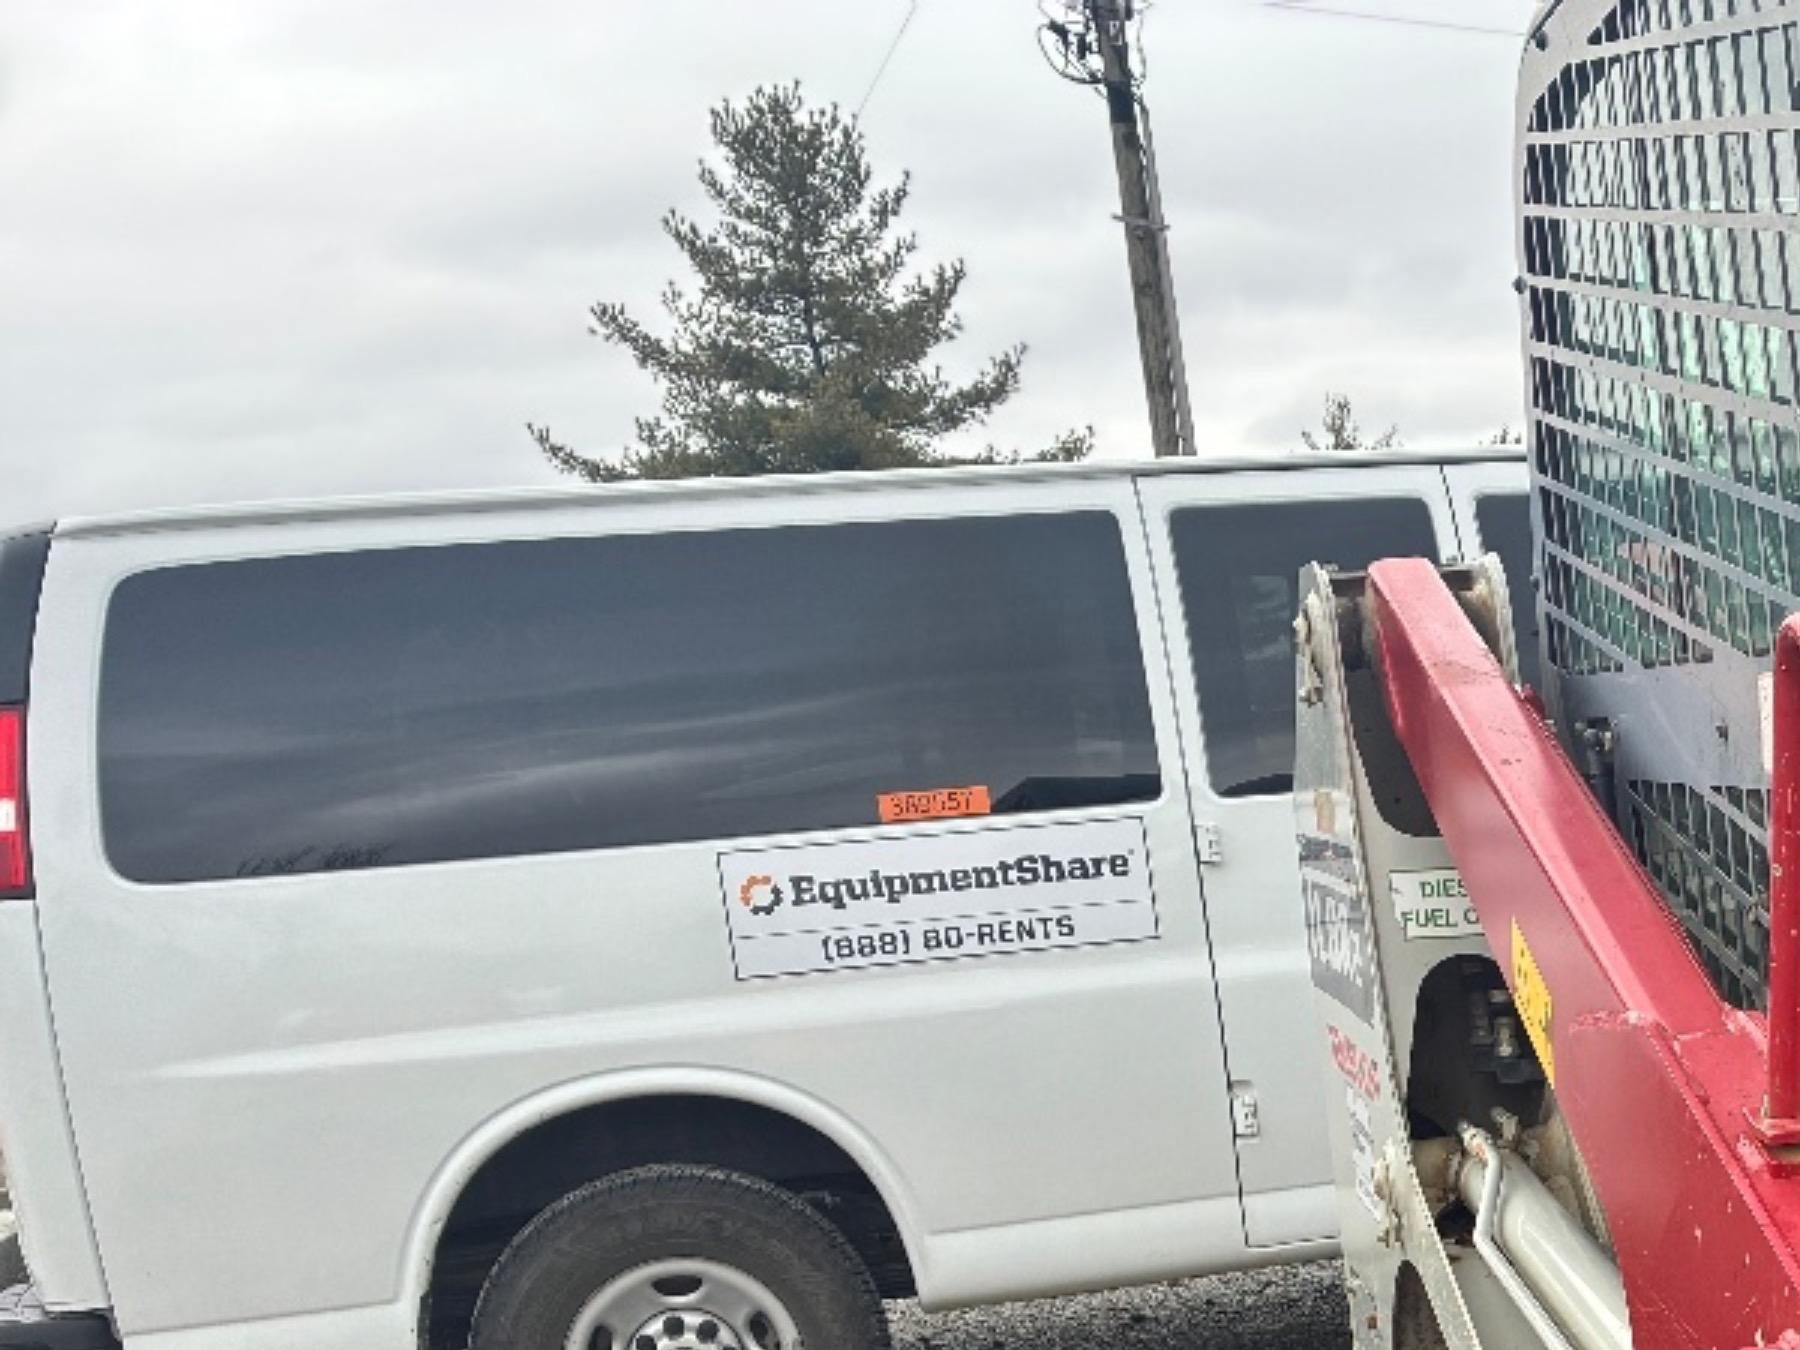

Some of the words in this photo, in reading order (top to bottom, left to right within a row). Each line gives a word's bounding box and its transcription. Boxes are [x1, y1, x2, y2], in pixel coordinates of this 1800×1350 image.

[789, 852, 1131, 909] EquipmentShare
[1419, 878, 1468, 898] DIES
[1400, 907, 1459, 928] FUEL
[822, 929, 910, 963] (888)
[923, 914, 1075, 950] 80-RENTS
